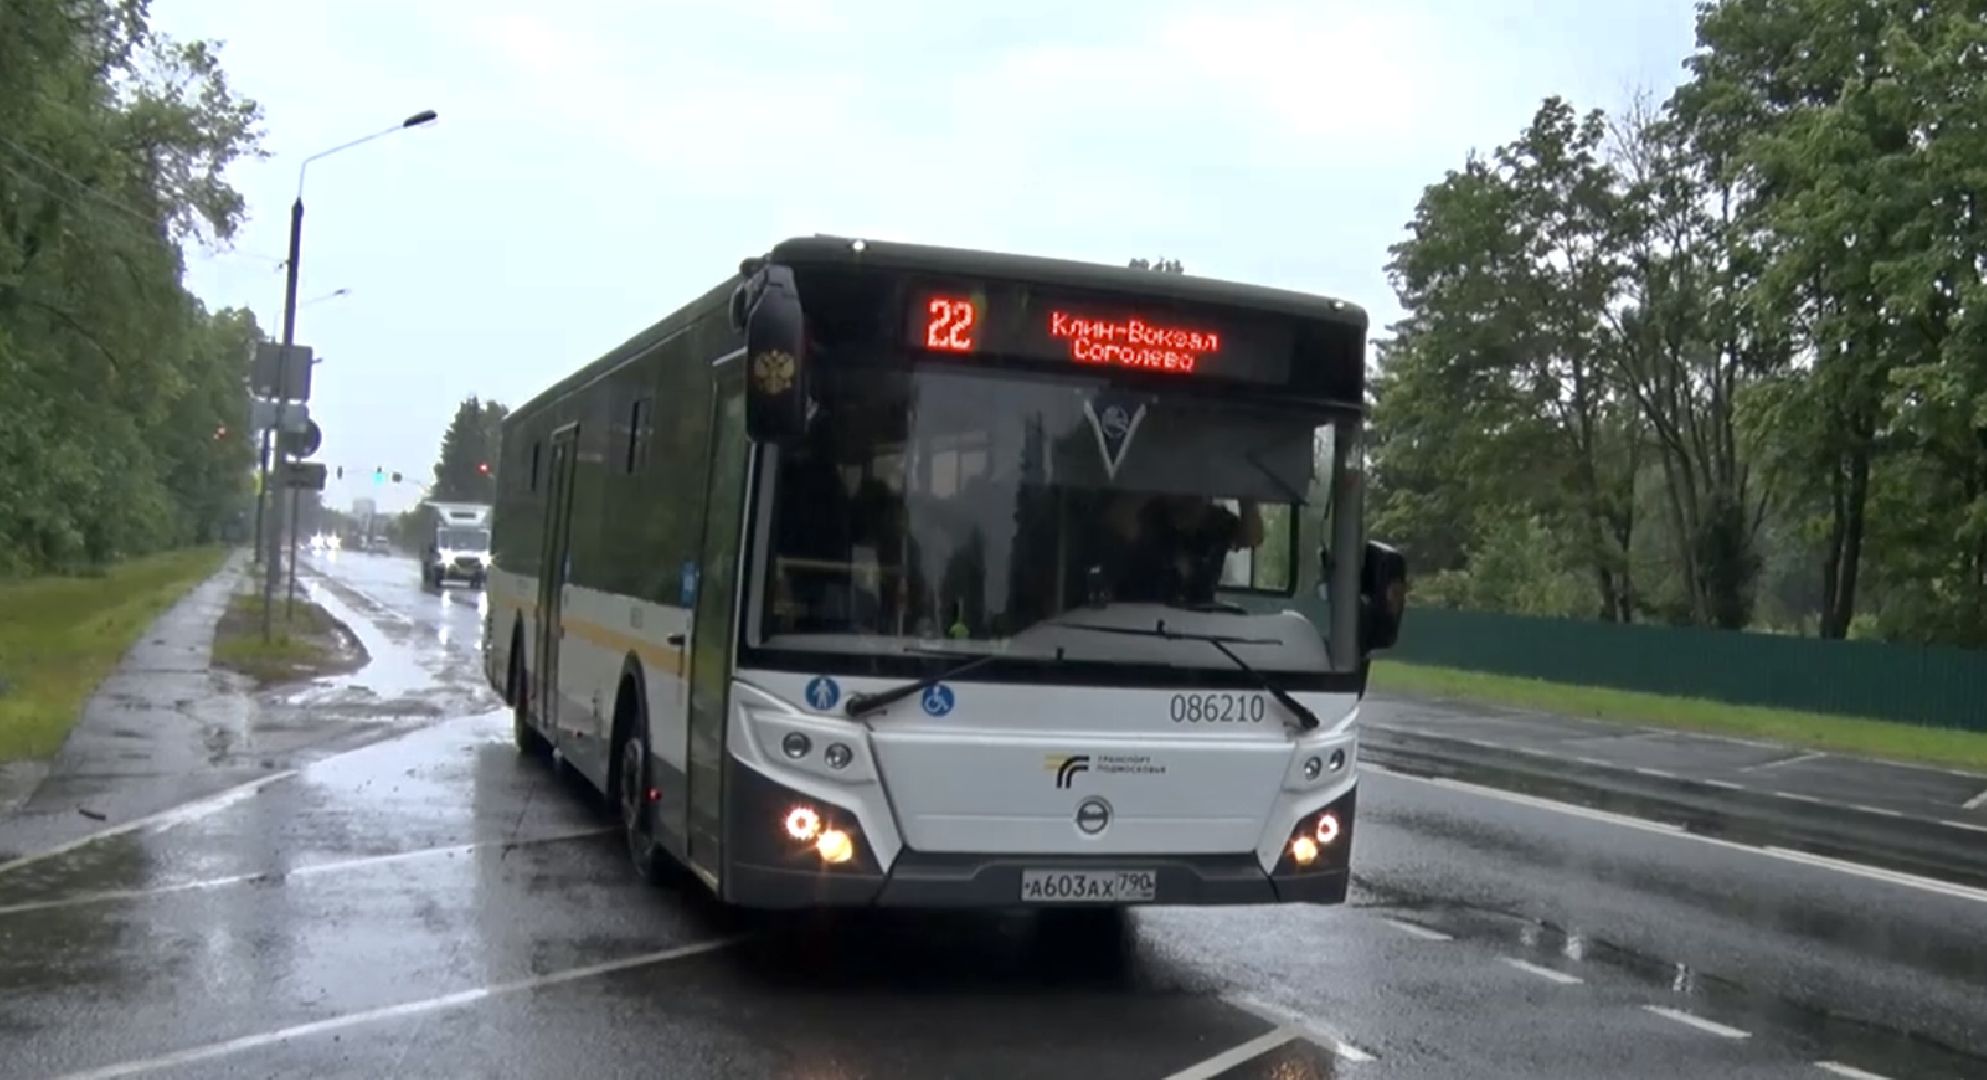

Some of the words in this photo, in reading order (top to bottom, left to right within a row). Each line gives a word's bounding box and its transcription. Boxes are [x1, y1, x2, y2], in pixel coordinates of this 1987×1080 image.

[927, 299, 974, 350] 22
[1051, 310, 1219, 352] Клин-Вокзал
[1170, 694, 1265, 723] 086210
